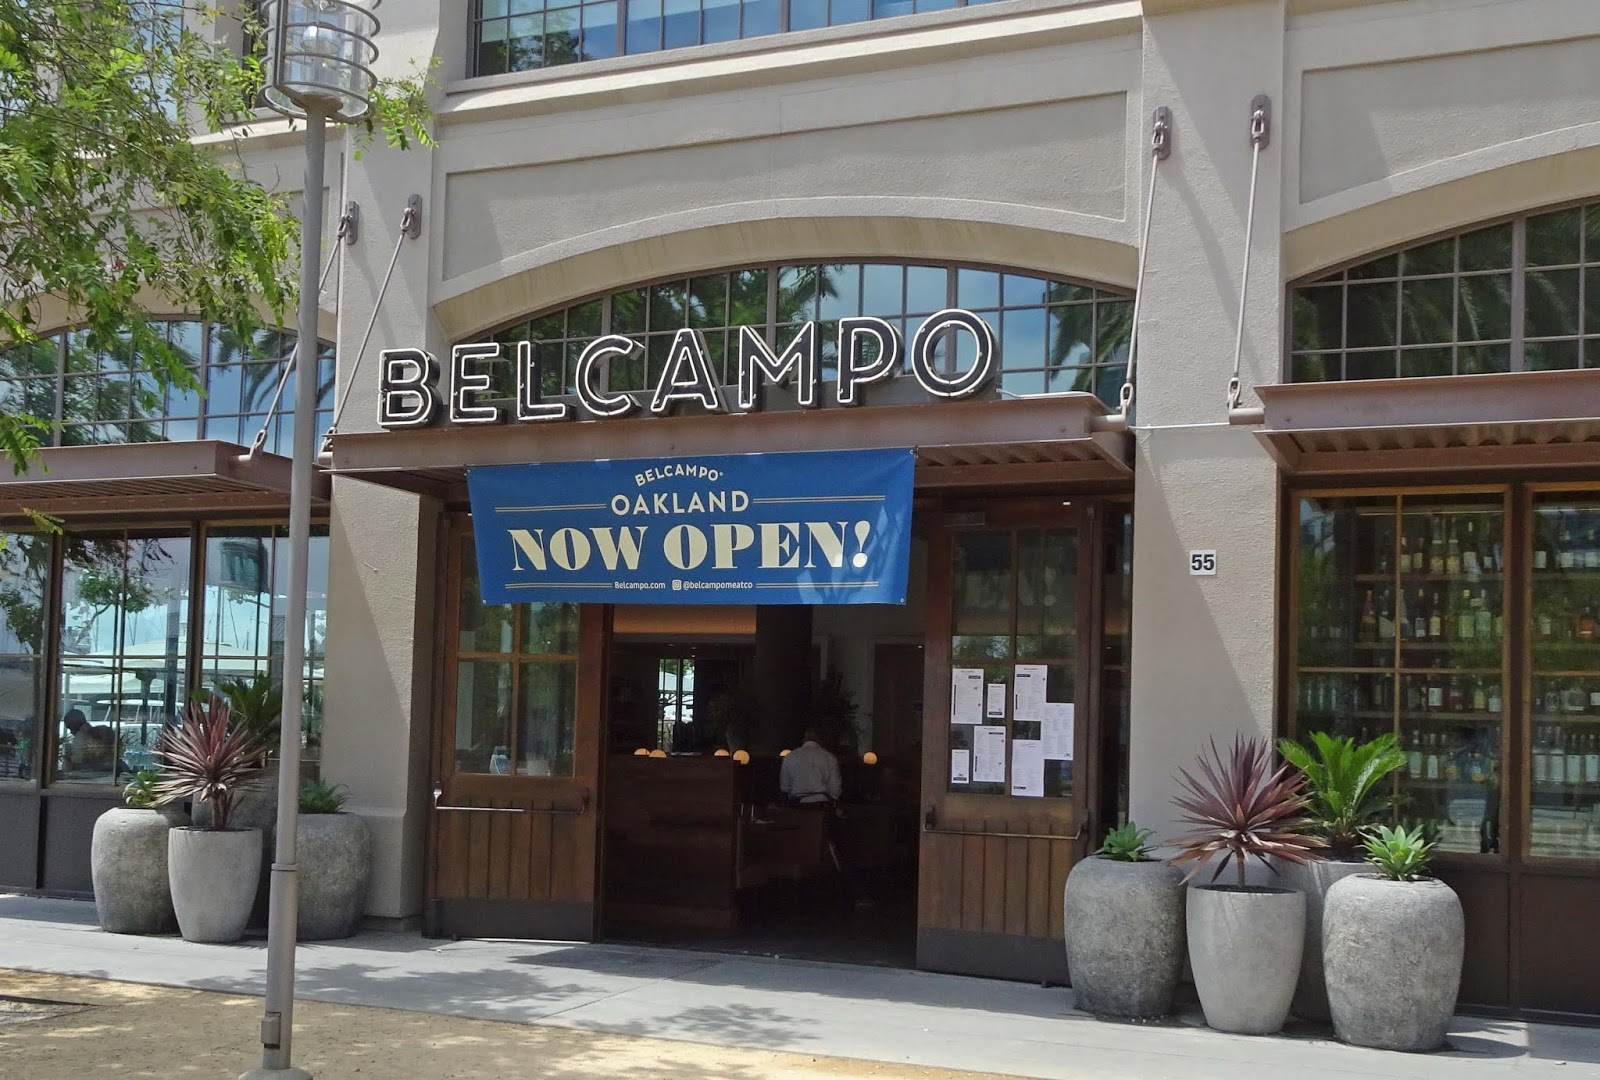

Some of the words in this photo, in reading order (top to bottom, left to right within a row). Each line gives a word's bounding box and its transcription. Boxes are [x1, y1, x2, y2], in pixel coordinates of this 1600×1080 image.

[376, 308, 995, 428] BELCAMPO
[610, 490, 749, 516] OAKLAND
[507, 526, 649, 571] NOW
[663, 520, 871, 570] OPEN!
[1191, 553, 1215, 571] 55
[614, 580, 666, 591] Belcampo.com
[683, 580, 753, 591] @belcampomeatco
